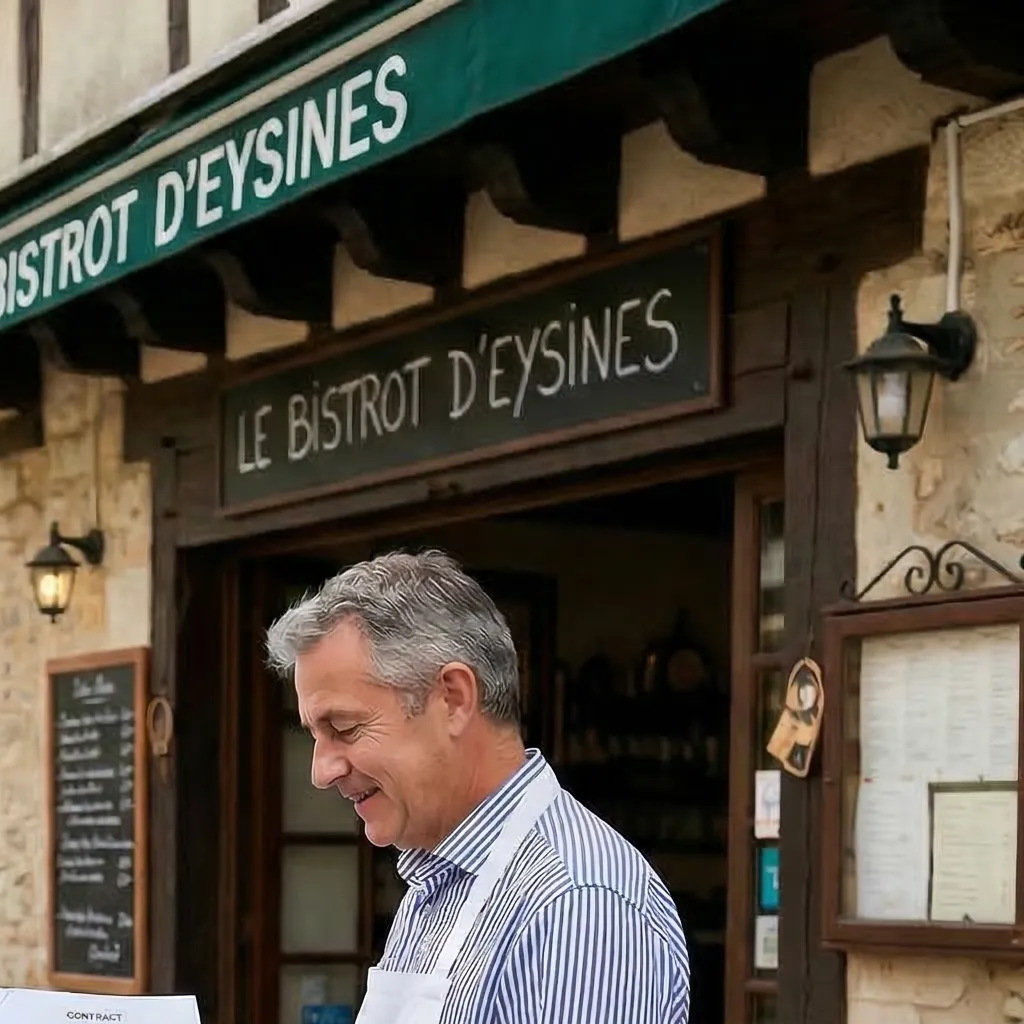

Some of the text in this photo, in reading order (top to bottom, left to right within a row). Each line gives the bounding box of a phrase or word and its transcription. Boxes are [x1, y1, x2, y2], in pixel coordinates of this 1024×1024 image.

[154, 54, 408, 248] D'EYSINES
[238, 405, 272, 474] LE
[66, 1011, 123, 1022] CONTRACT
